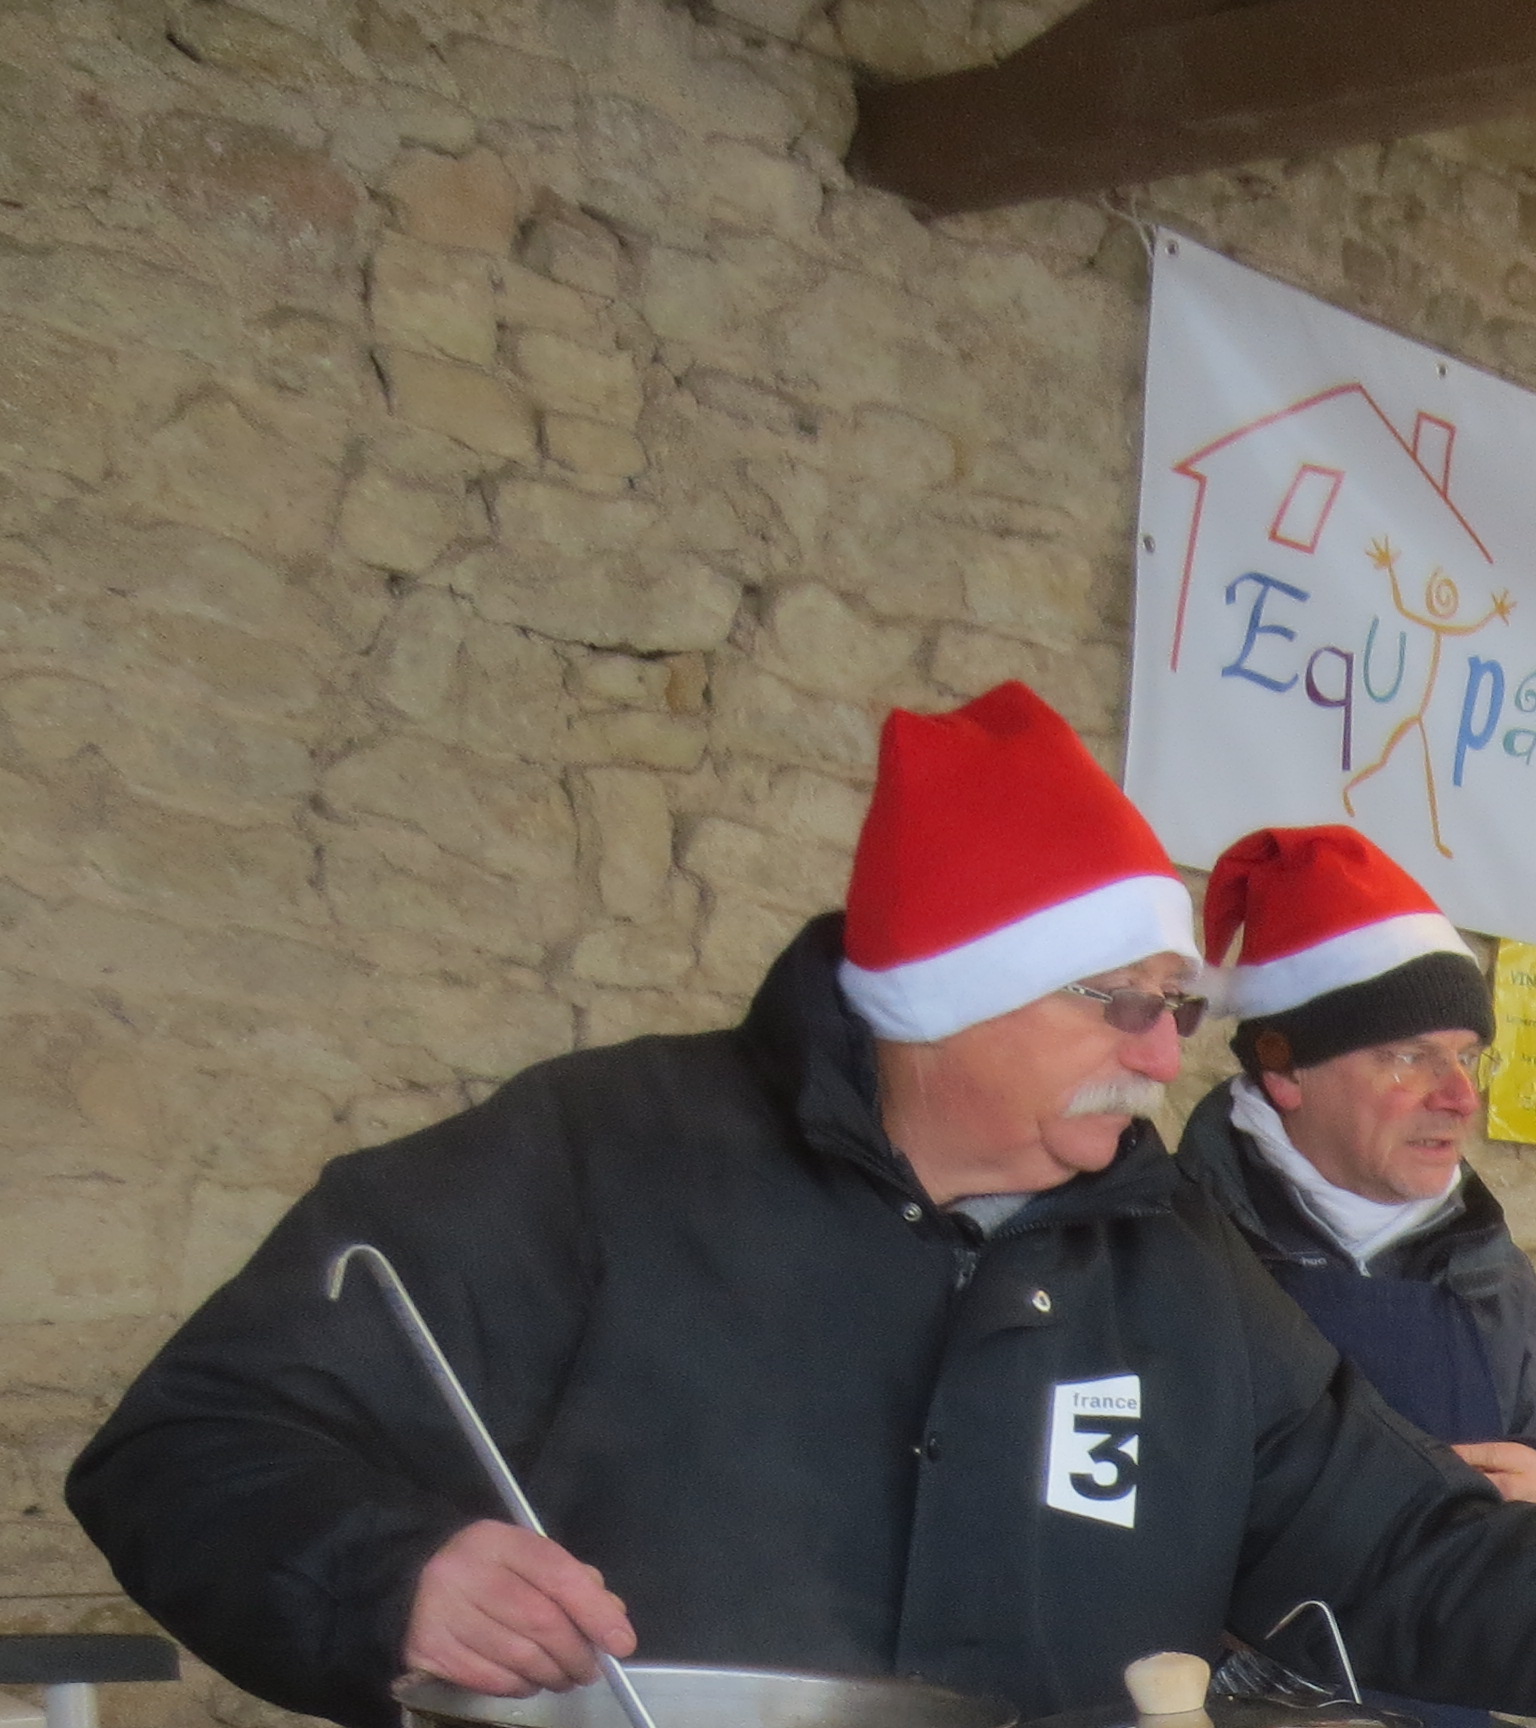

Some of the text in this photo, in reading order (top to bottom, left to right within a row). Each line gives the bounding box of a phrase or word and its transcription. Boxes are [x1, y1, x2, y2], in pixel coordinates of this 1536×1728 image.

[1510, 969, 1536, 989] VIN
[1073, 1392, 1138, 1410] france
[1068, 1413, 1142, 1502] 3
